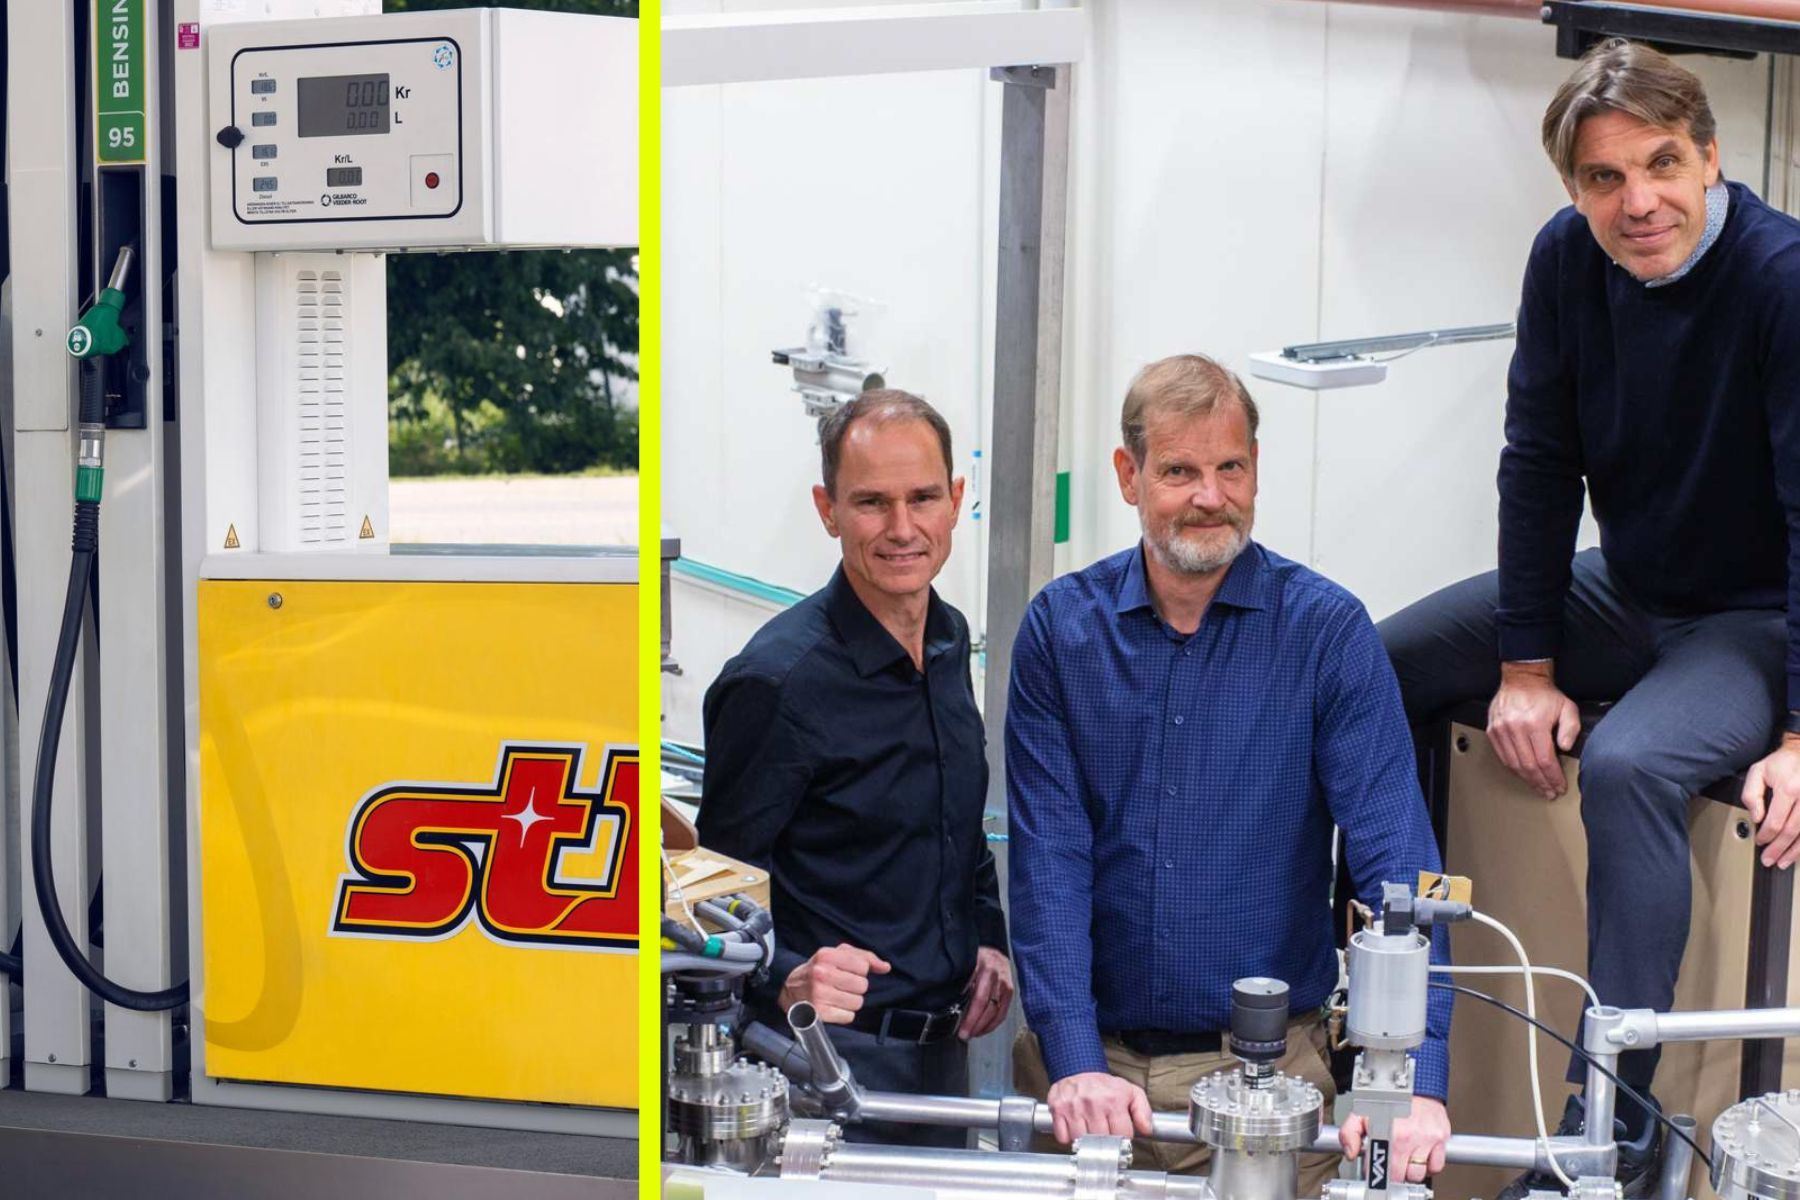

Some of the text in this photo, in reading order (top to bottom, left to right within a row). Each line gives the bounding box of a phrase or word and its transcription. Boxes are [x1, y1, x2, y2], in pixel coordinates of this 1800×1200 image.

[112, 0, 129, 97] BENSIN
[395, 86, 411, 99] Kr
[394, 112, 403, 124] L
[108, 127, 135, 147] 95
[334, 154, 353, 164] Kr/L
[1372, 1142, 1386, 1187] VAT
